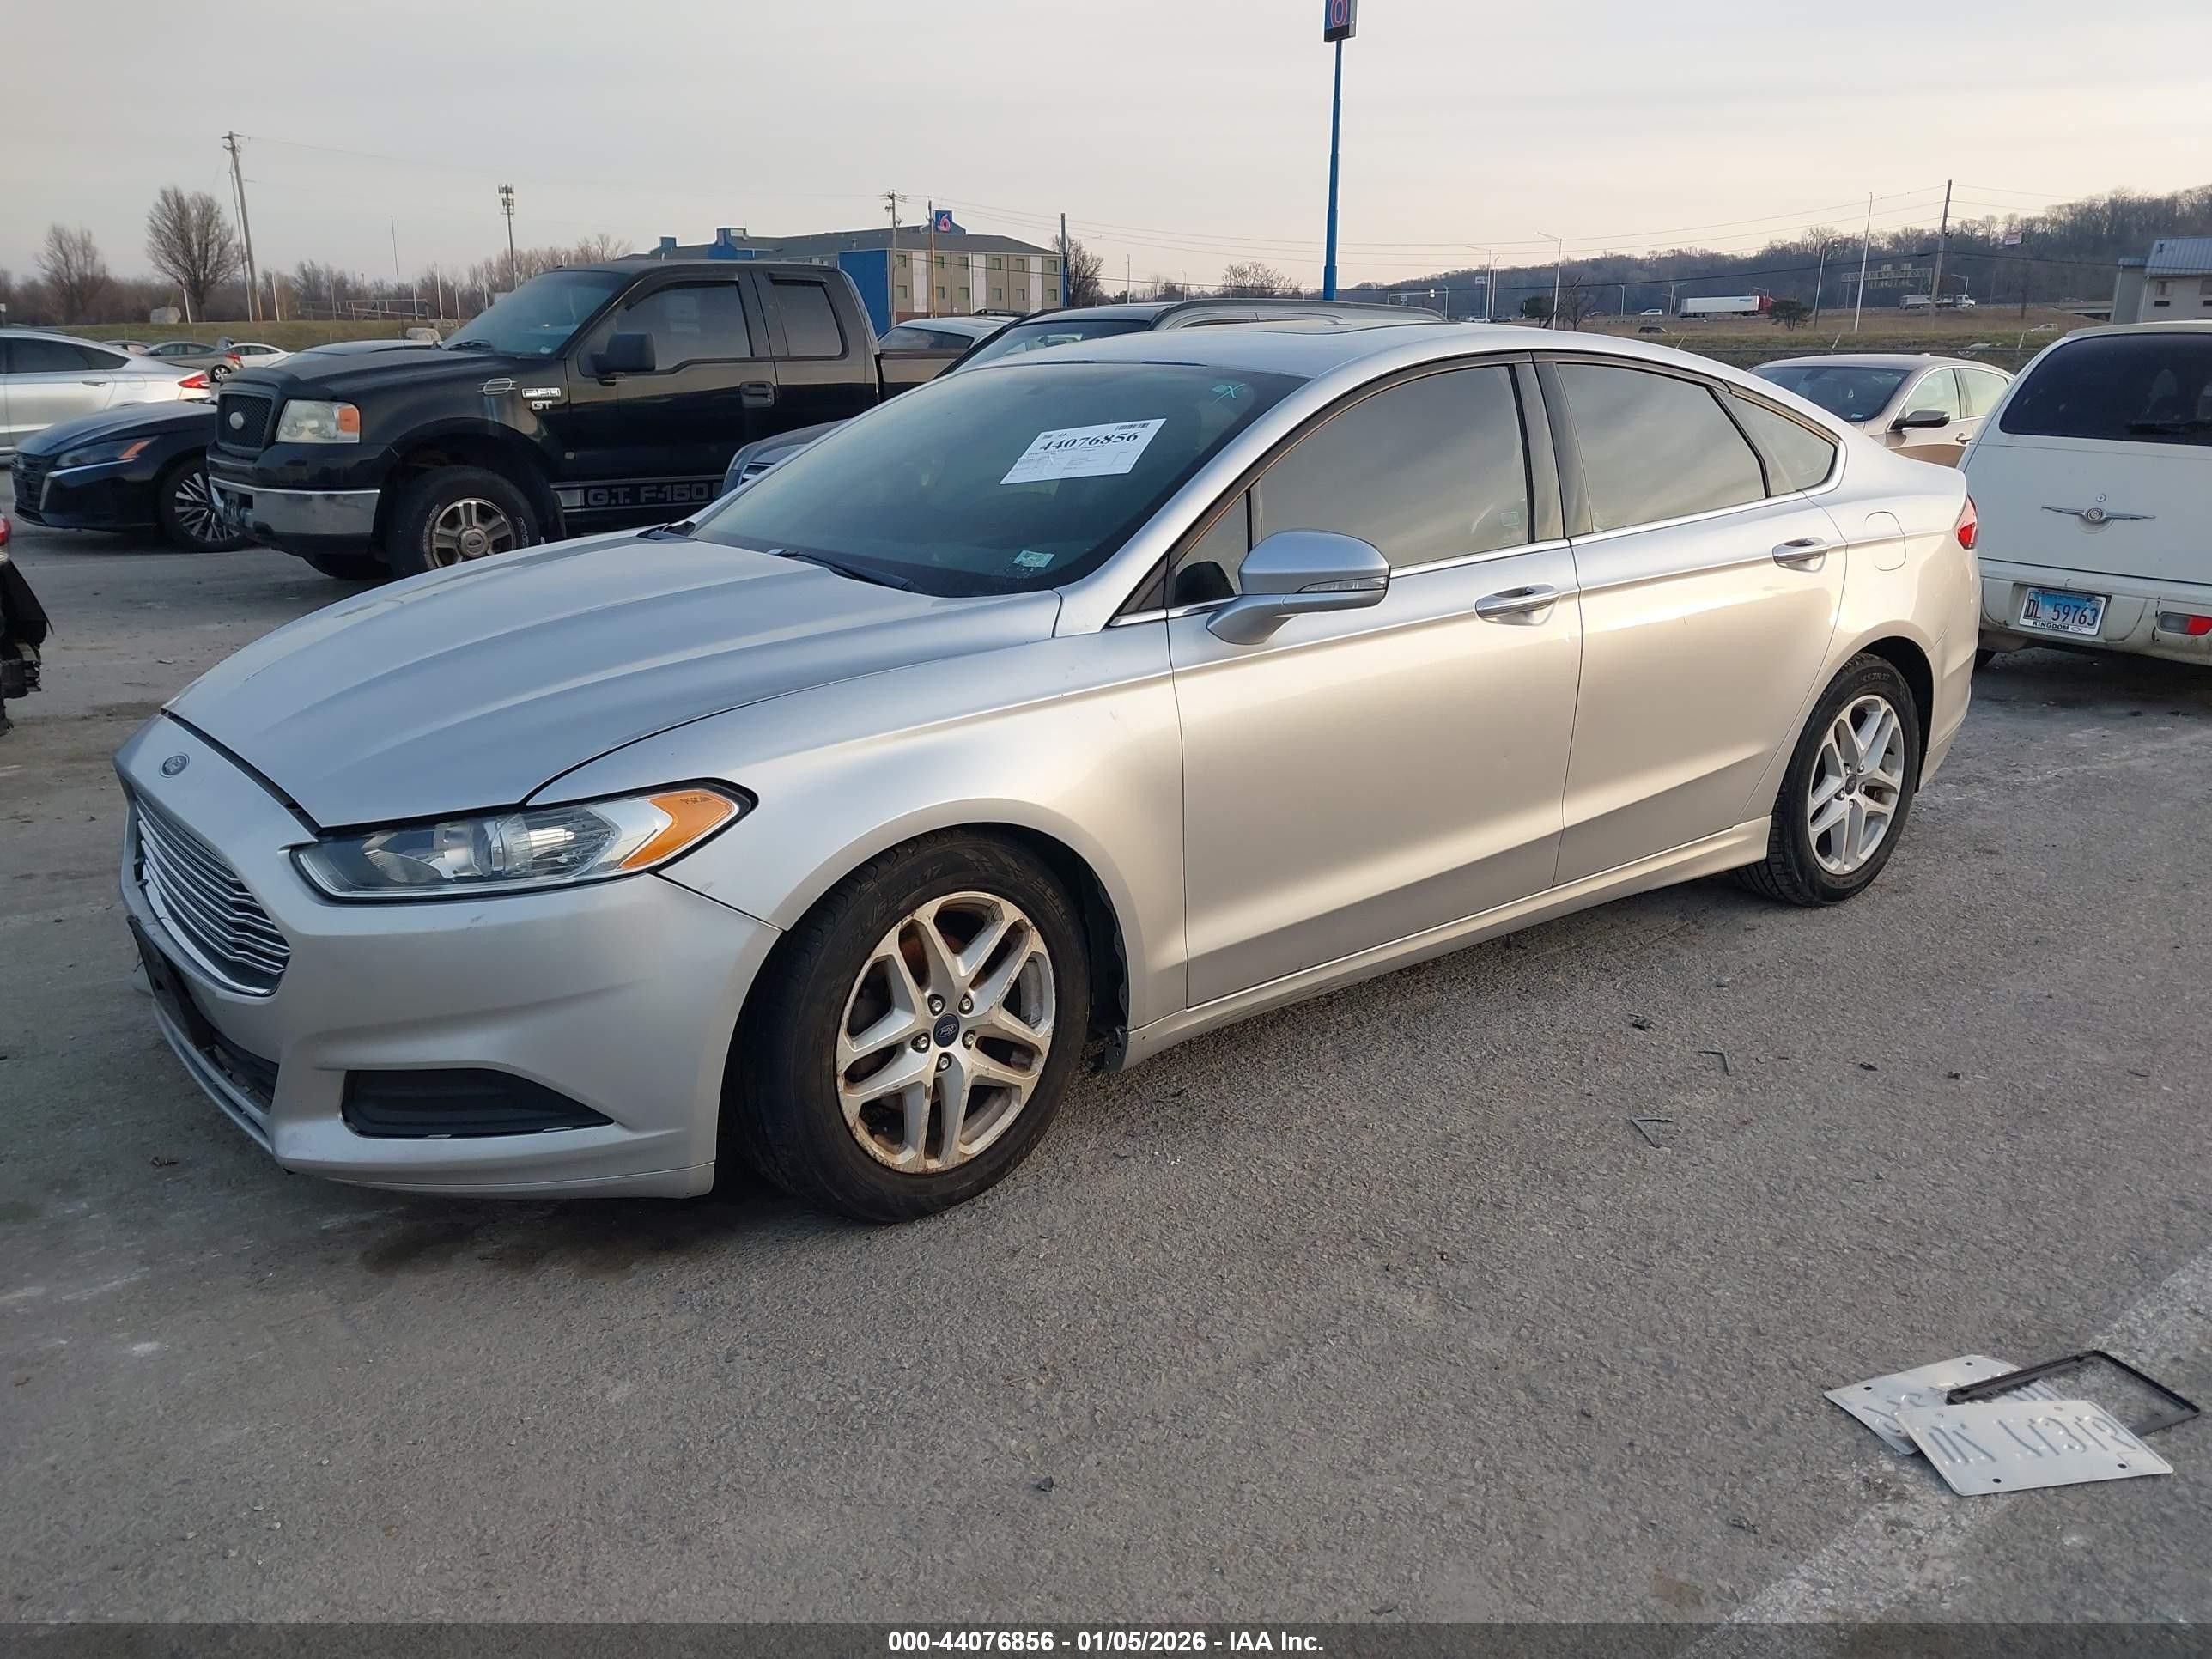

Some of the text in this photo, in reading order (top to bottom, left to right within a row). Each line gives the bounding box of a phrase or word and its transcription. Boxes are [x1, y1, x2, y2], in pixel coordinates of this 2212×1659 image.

[531, 400, 553, 410] GT
[1039, 431, 1140, 451] 44076856
[587, 483, 708, 507] G.T. F-150
[2023, 599, 2098, 626] DL 59763
[2032, 621, 2069, 630] KINGDOM
